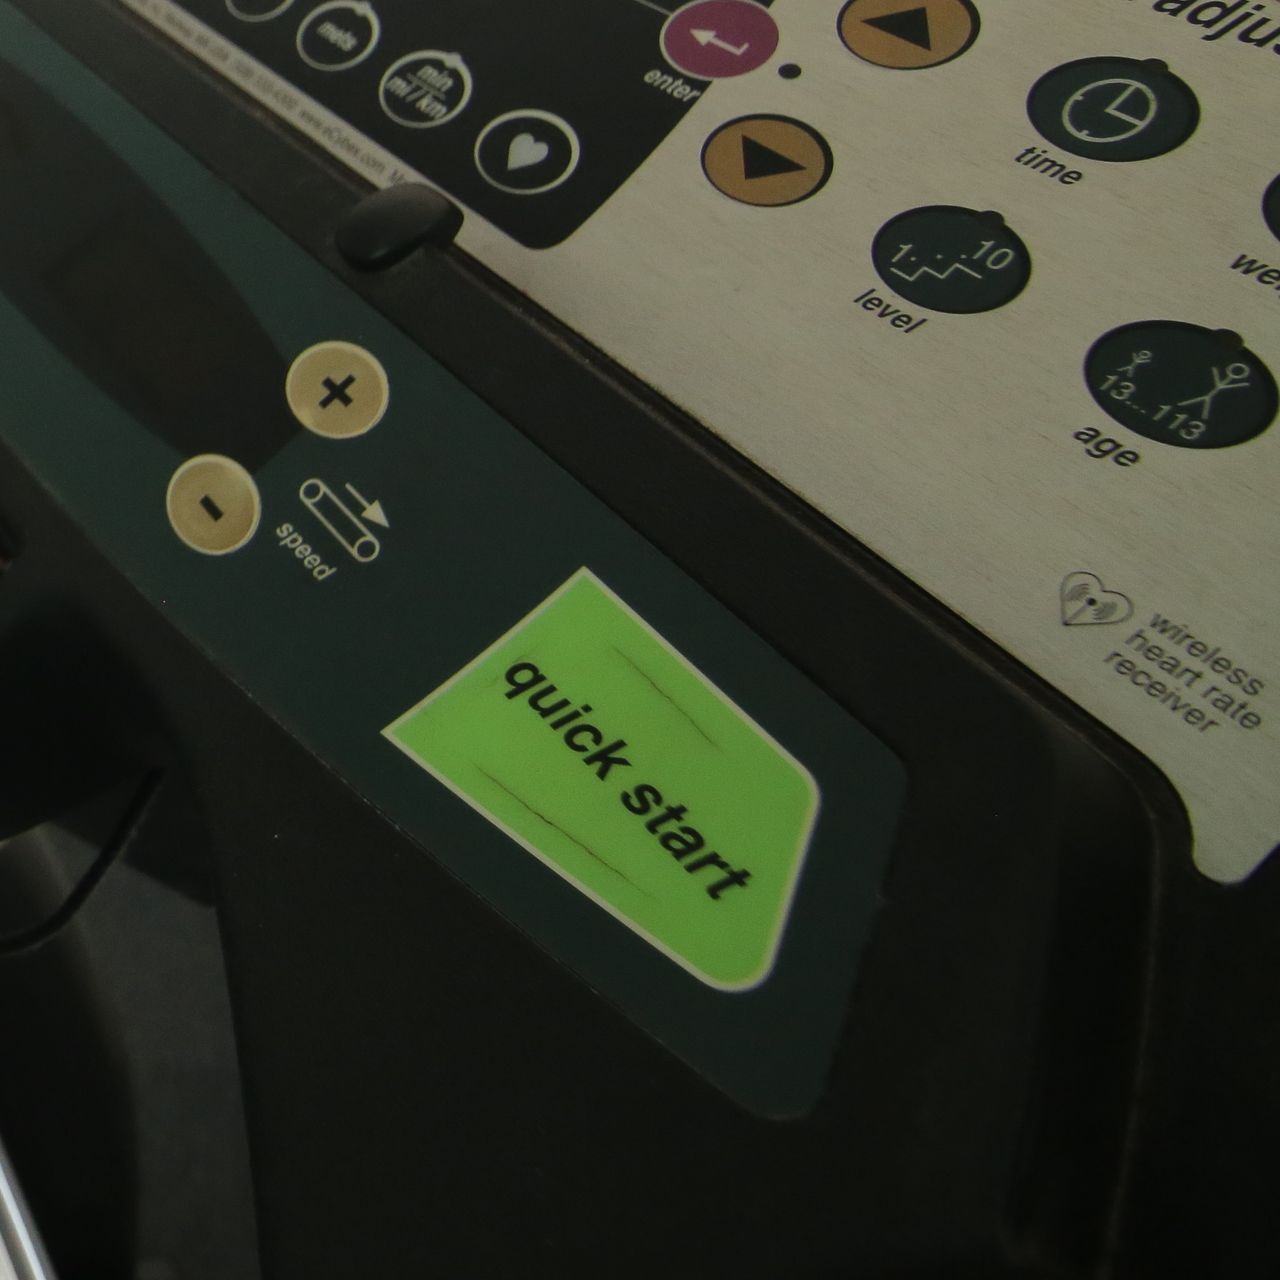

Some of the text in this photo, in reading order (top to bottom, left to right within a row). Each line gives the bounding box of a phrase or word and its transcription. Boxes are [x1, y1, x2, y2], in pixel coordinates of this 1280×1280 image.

[643, 69, 701, 102] enter
[1014, 146, 1083, 185] time
[853, 288, 928, 333] level
[1072, 426, 1141, 467] age
[276, 523, 337, 580] speed
[1124, 628, 1262, 730] heart rate
[1149, 613, 1264, 696] wireless
[1103, 650, 1220, 732] receiver
[504, 661, 752, 901] quick start
